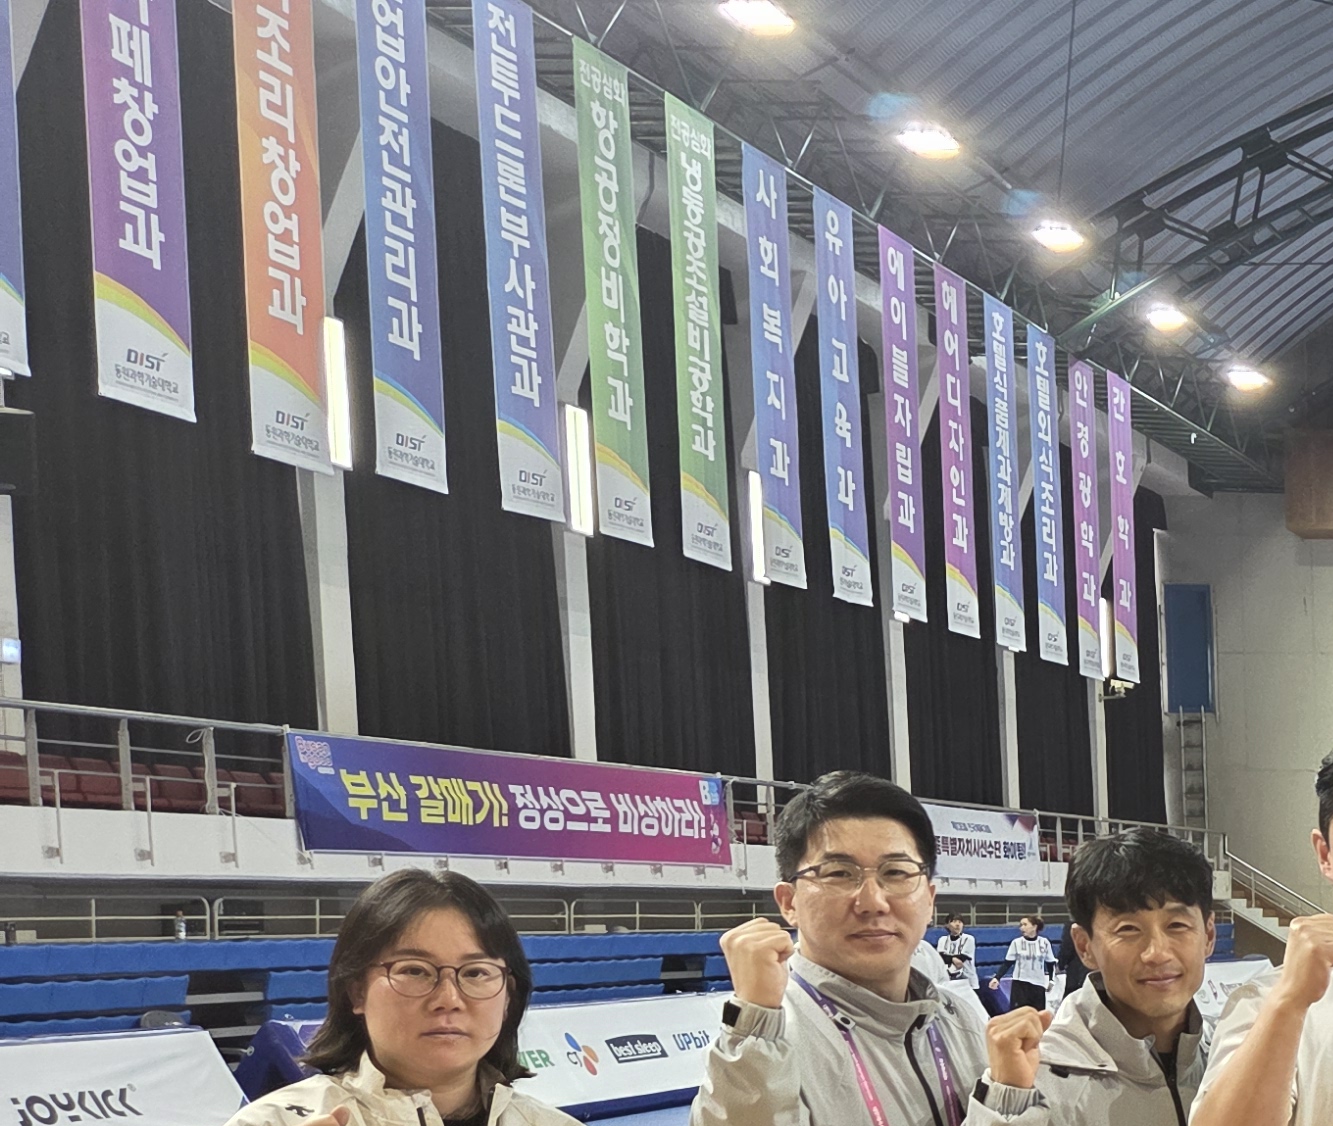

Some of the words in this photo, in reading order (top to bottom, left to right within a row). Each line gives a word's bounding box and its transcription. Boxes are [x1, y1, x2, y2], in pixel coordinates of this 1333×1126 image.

[109, 0, 165, 270] 페창업과
[256, 0, 306, 335] 조리창업과
[579, 59, 626, 107] 전공심화
[670, 114, 712, 161] 전공심화
[487, 2, 541, 407] 전투드론부사관과
[590, 101, 633, 430] 항공정비학과
[678, 151, 715, 461] 냉동공조설비공학과
[115, 364, 179, 394] 동원과학기술대학교
[126, 349, 166, 372] DIST
[275, 411, 308, 431] DIST
[395, 433, 426, 452] DIST
[755, 169, 790, 486] 사회복지과
[825, 209, 855, 511] 유아교육과
[887, 246, 915, 533] 에이블자립과
[942, 280, 968, 553] 헤어디자인과
[518, 470, 547, 487] DIST
[1035, 341, 1058, 586] 호텔외식조리과
[1074, 370, 1096, 606] 안경광학과
[1112, 386, 1132, 611] 간호학과
[339, 769, 409, 822] 부산
[409, 775, 508, 828] 갈매기!
[509, 784, 611, 833] 정상으로
[611, 793, 706, 839] 비상하라!
[518, 1048, 555, 1069] VER
[609, 1040, 634, 1055] best
[635, 1039, 662, 1055] sleep
